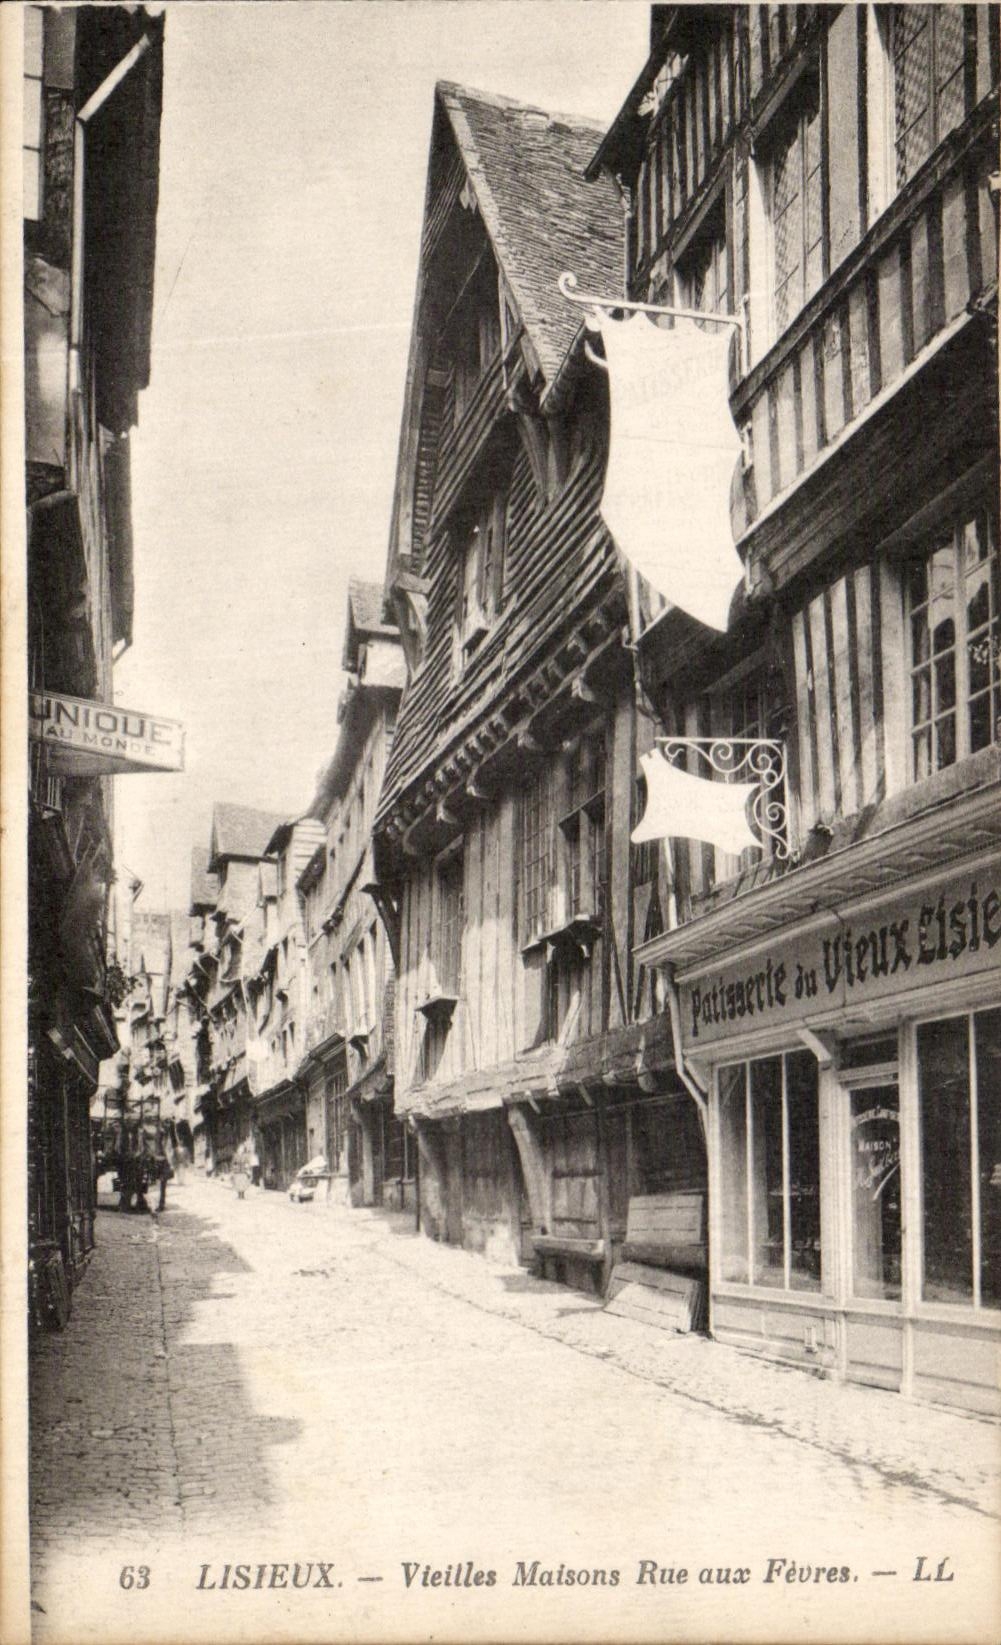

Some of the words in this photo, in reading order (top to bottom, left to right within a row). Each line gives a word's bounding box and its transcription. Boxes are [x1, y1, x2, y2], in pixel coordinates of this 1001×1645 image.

[29, 697, 173, 745] UNIQUE
[46, 726, 73, 739] AU
[82, 733, 155, 756] MONDE
[795, 964, 818, 1000] du
[822, 918, 912, 994] Vieux
